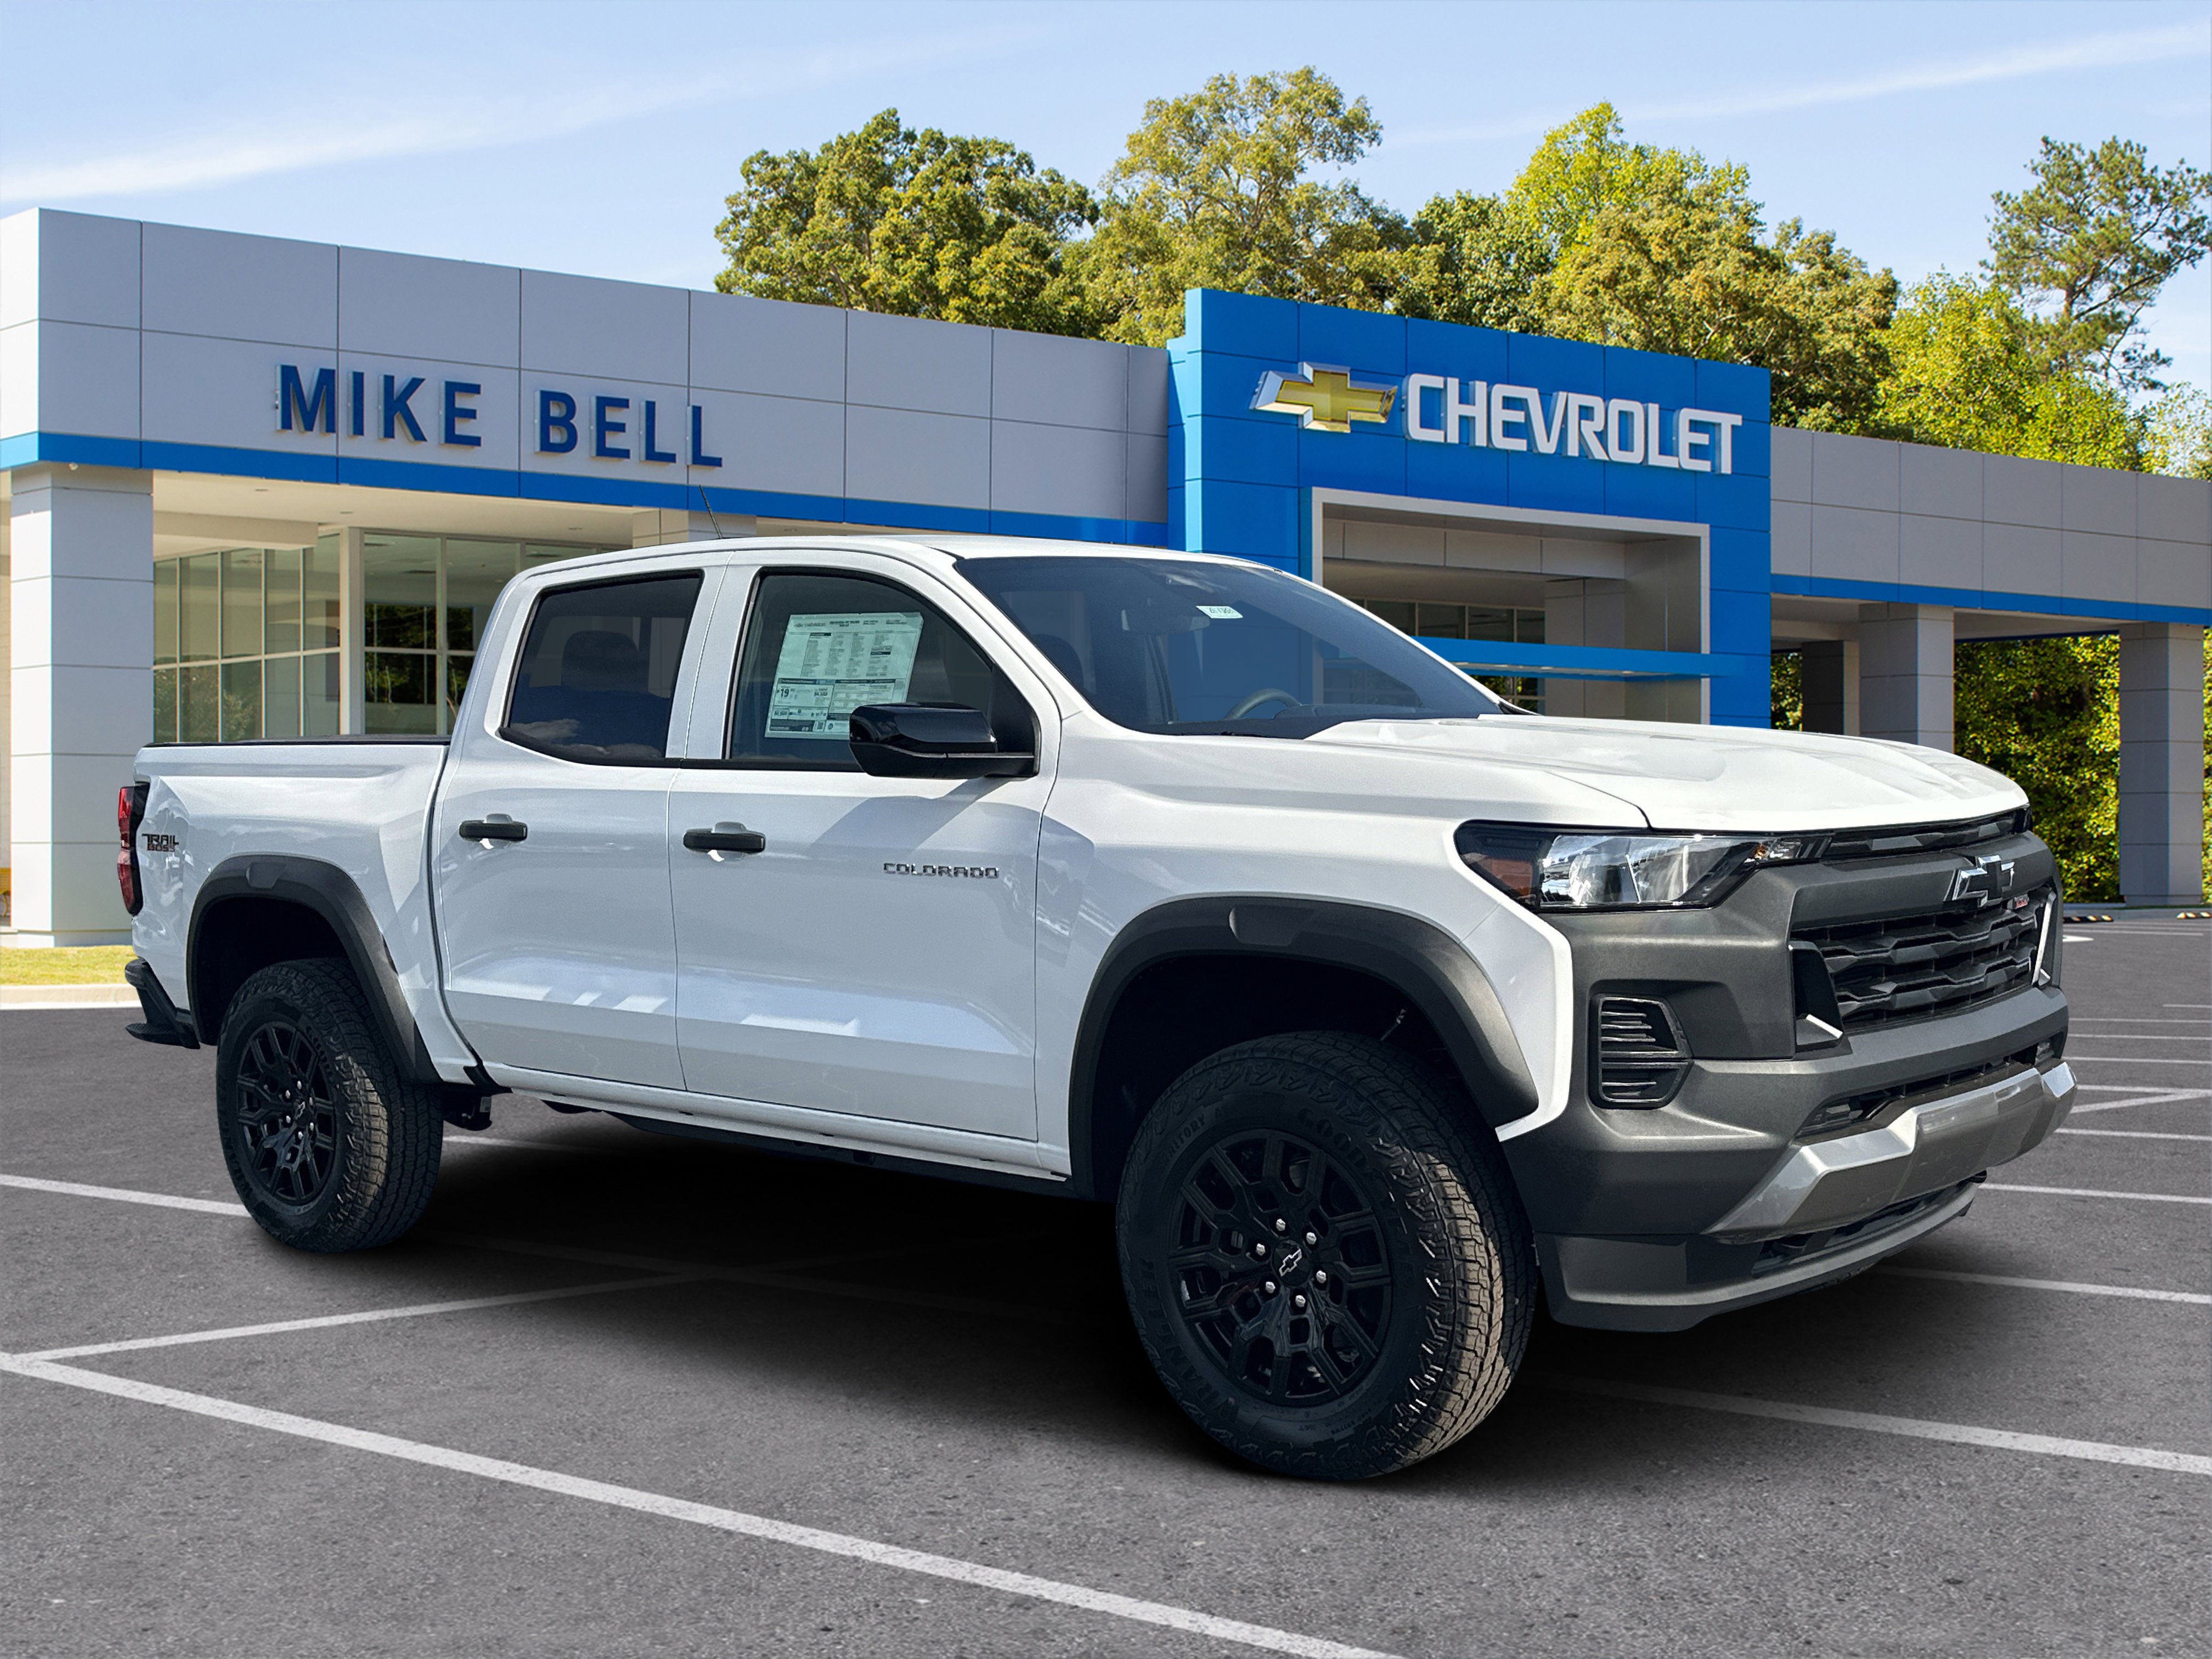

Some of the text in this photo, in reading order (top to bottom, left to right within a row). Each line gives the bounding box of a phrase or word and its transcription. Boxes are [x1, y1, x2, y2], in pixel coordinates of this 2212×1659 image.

[275, 364, 723, 467] MIKE BELL
[1401, 373, 1743, 475] CHEVROLET
[142, 833, 179, 845] TRAIL
[146, 844, 176, 852] BOSS
[883, 862, 1000, 879] COLORADO
